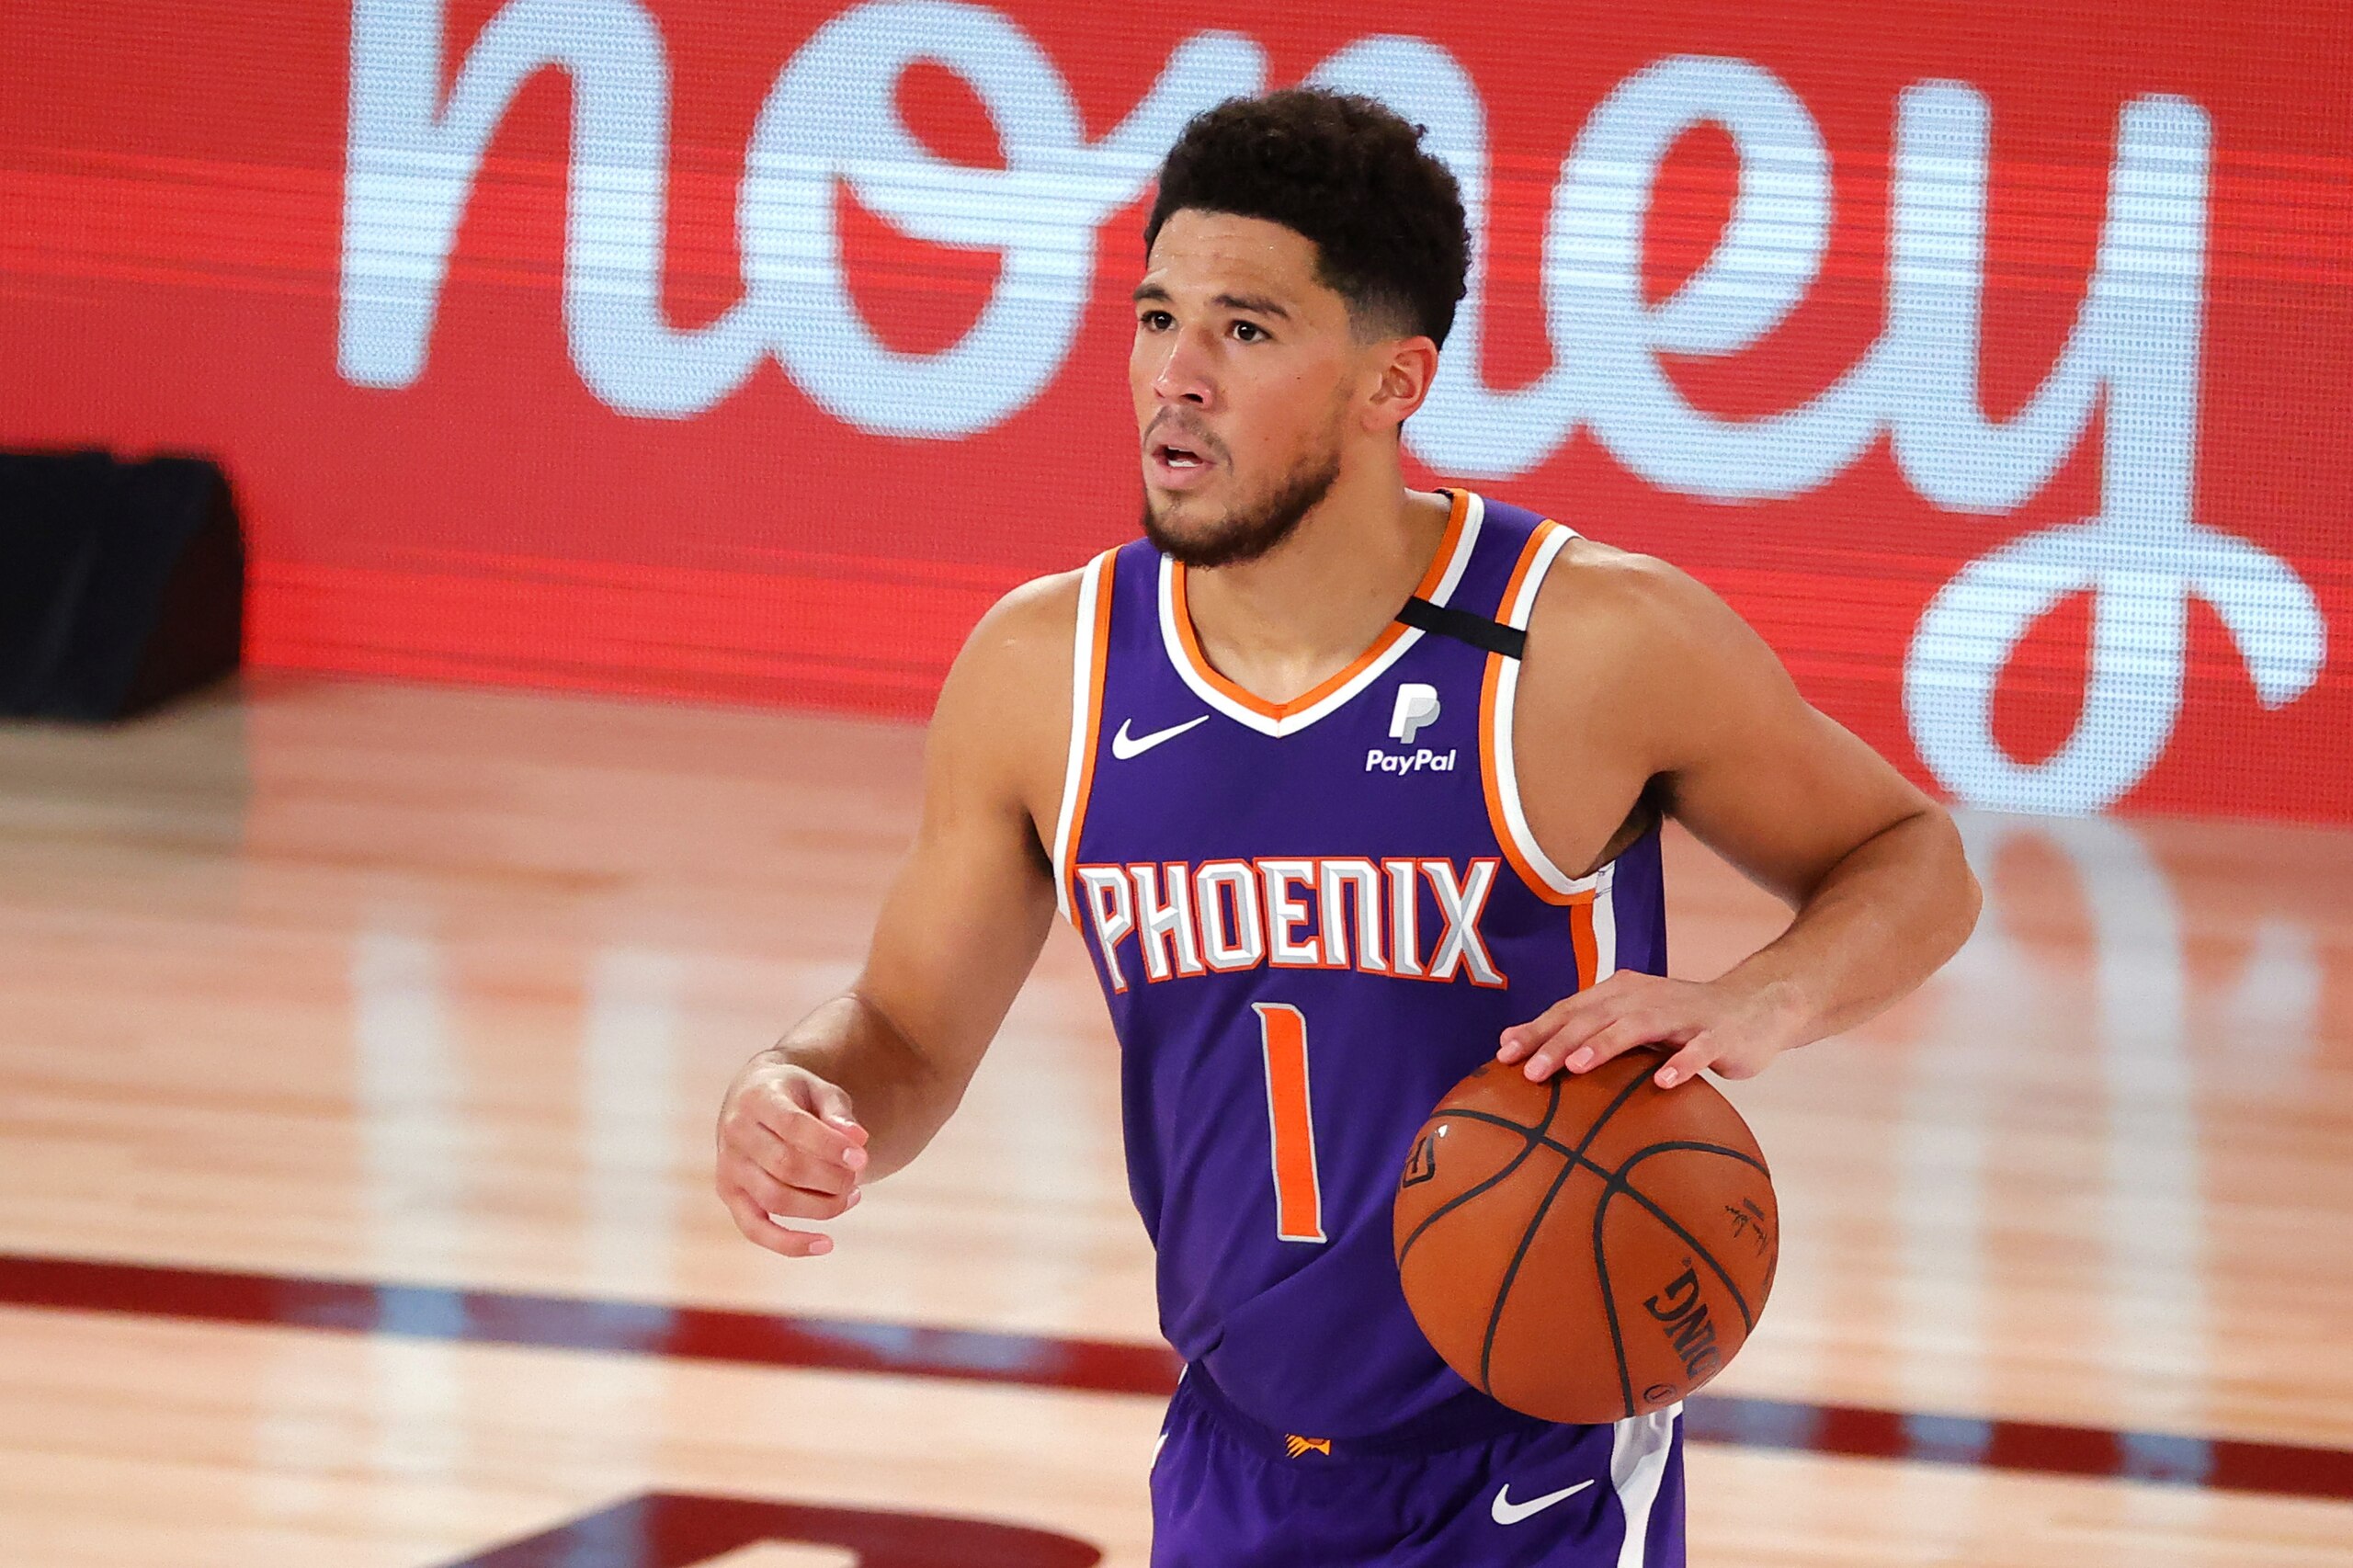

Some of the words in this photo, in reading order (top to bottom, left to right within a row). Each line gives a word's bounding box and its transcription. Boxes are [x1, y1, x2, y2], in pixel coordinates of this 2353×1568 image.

[1365, 748, 1457, 777] PayPal
[1075, 856, 1508, 994] PHOENIX
[1251, 1002, 1328, 1244] 1
